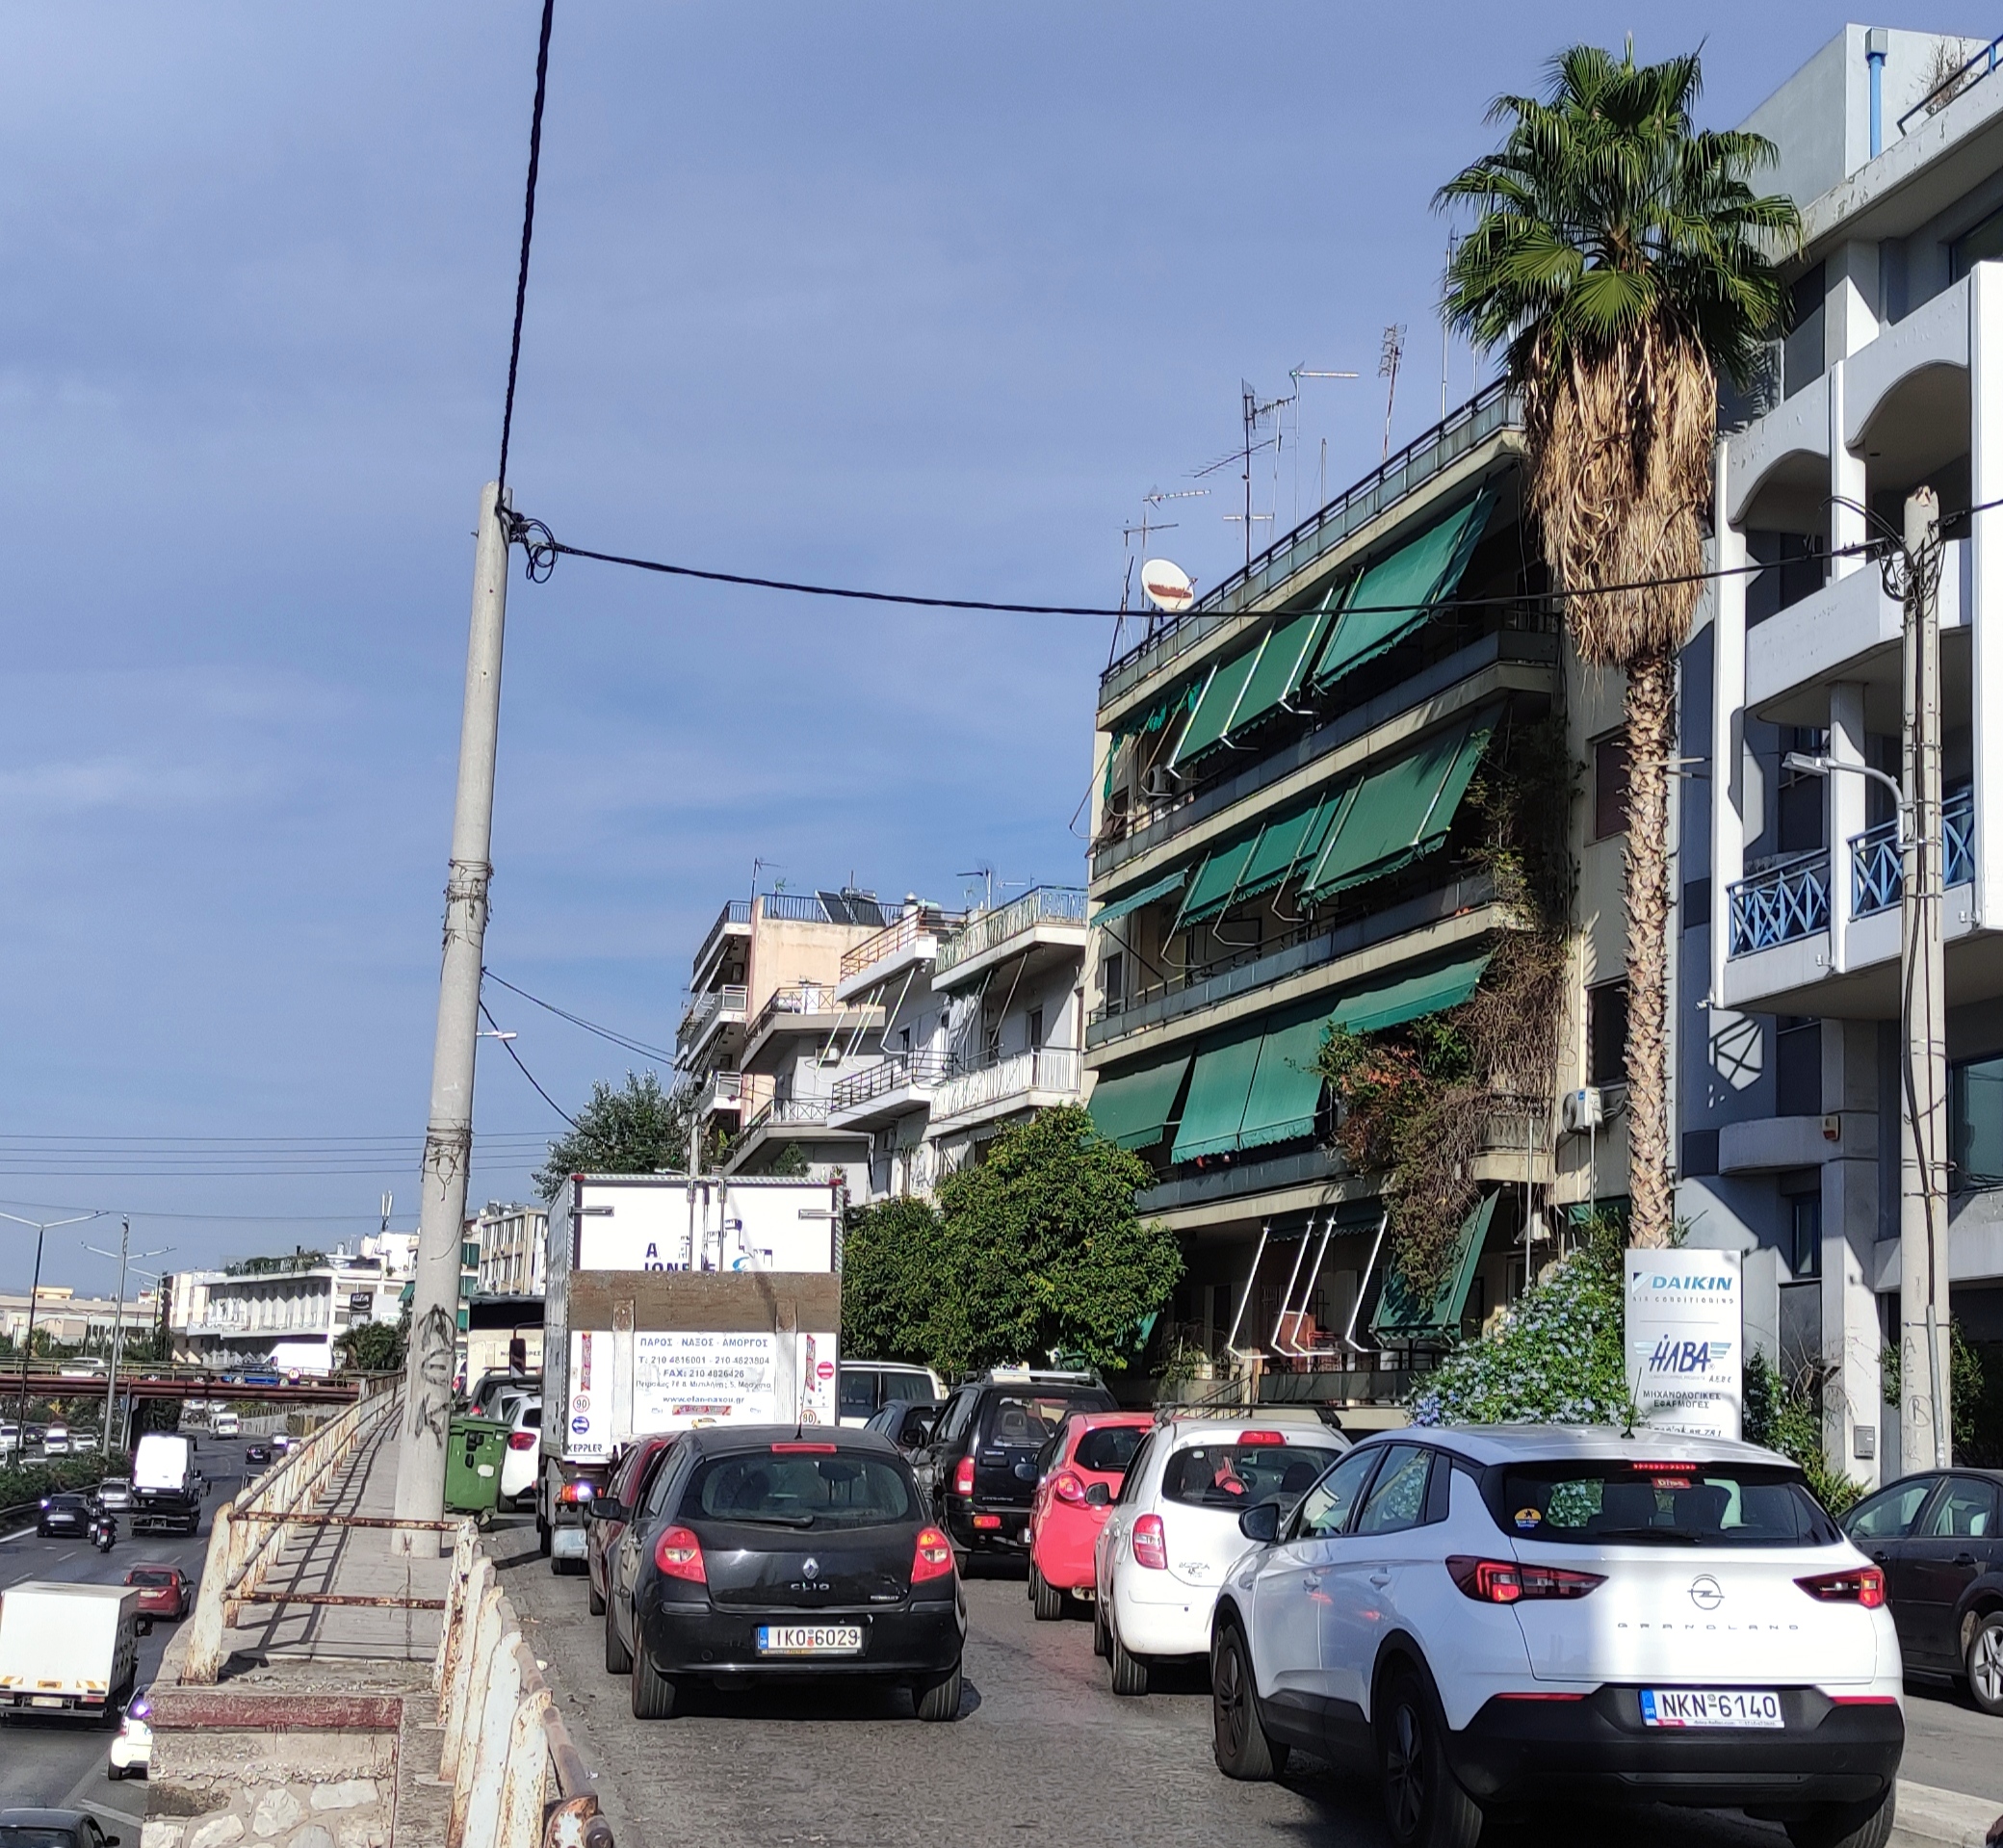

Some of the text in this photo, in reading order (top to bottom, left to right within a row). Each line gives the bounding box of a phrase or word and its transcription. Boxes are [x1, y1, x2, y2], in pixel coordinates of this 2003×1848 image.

[1652, 1276, 1732, 1290] DAIKIN
[640, 1338, 768, 1348] ΠΑΡΟΣ ΝΑΞΟΣ ΑΜΟΡΓΟΣ
[651, 1356, 666, 1365] 210
[715, 1356, 731, 1365] 210
[663, 1368, 687, 1378] FAX:
[689, 1368, 705, 1378] 210
[1653, 1399, 1710, 1409] ΕΦΑΡΜΟΓΕΣ
[791, 1582, 830, 1592] CLIO
